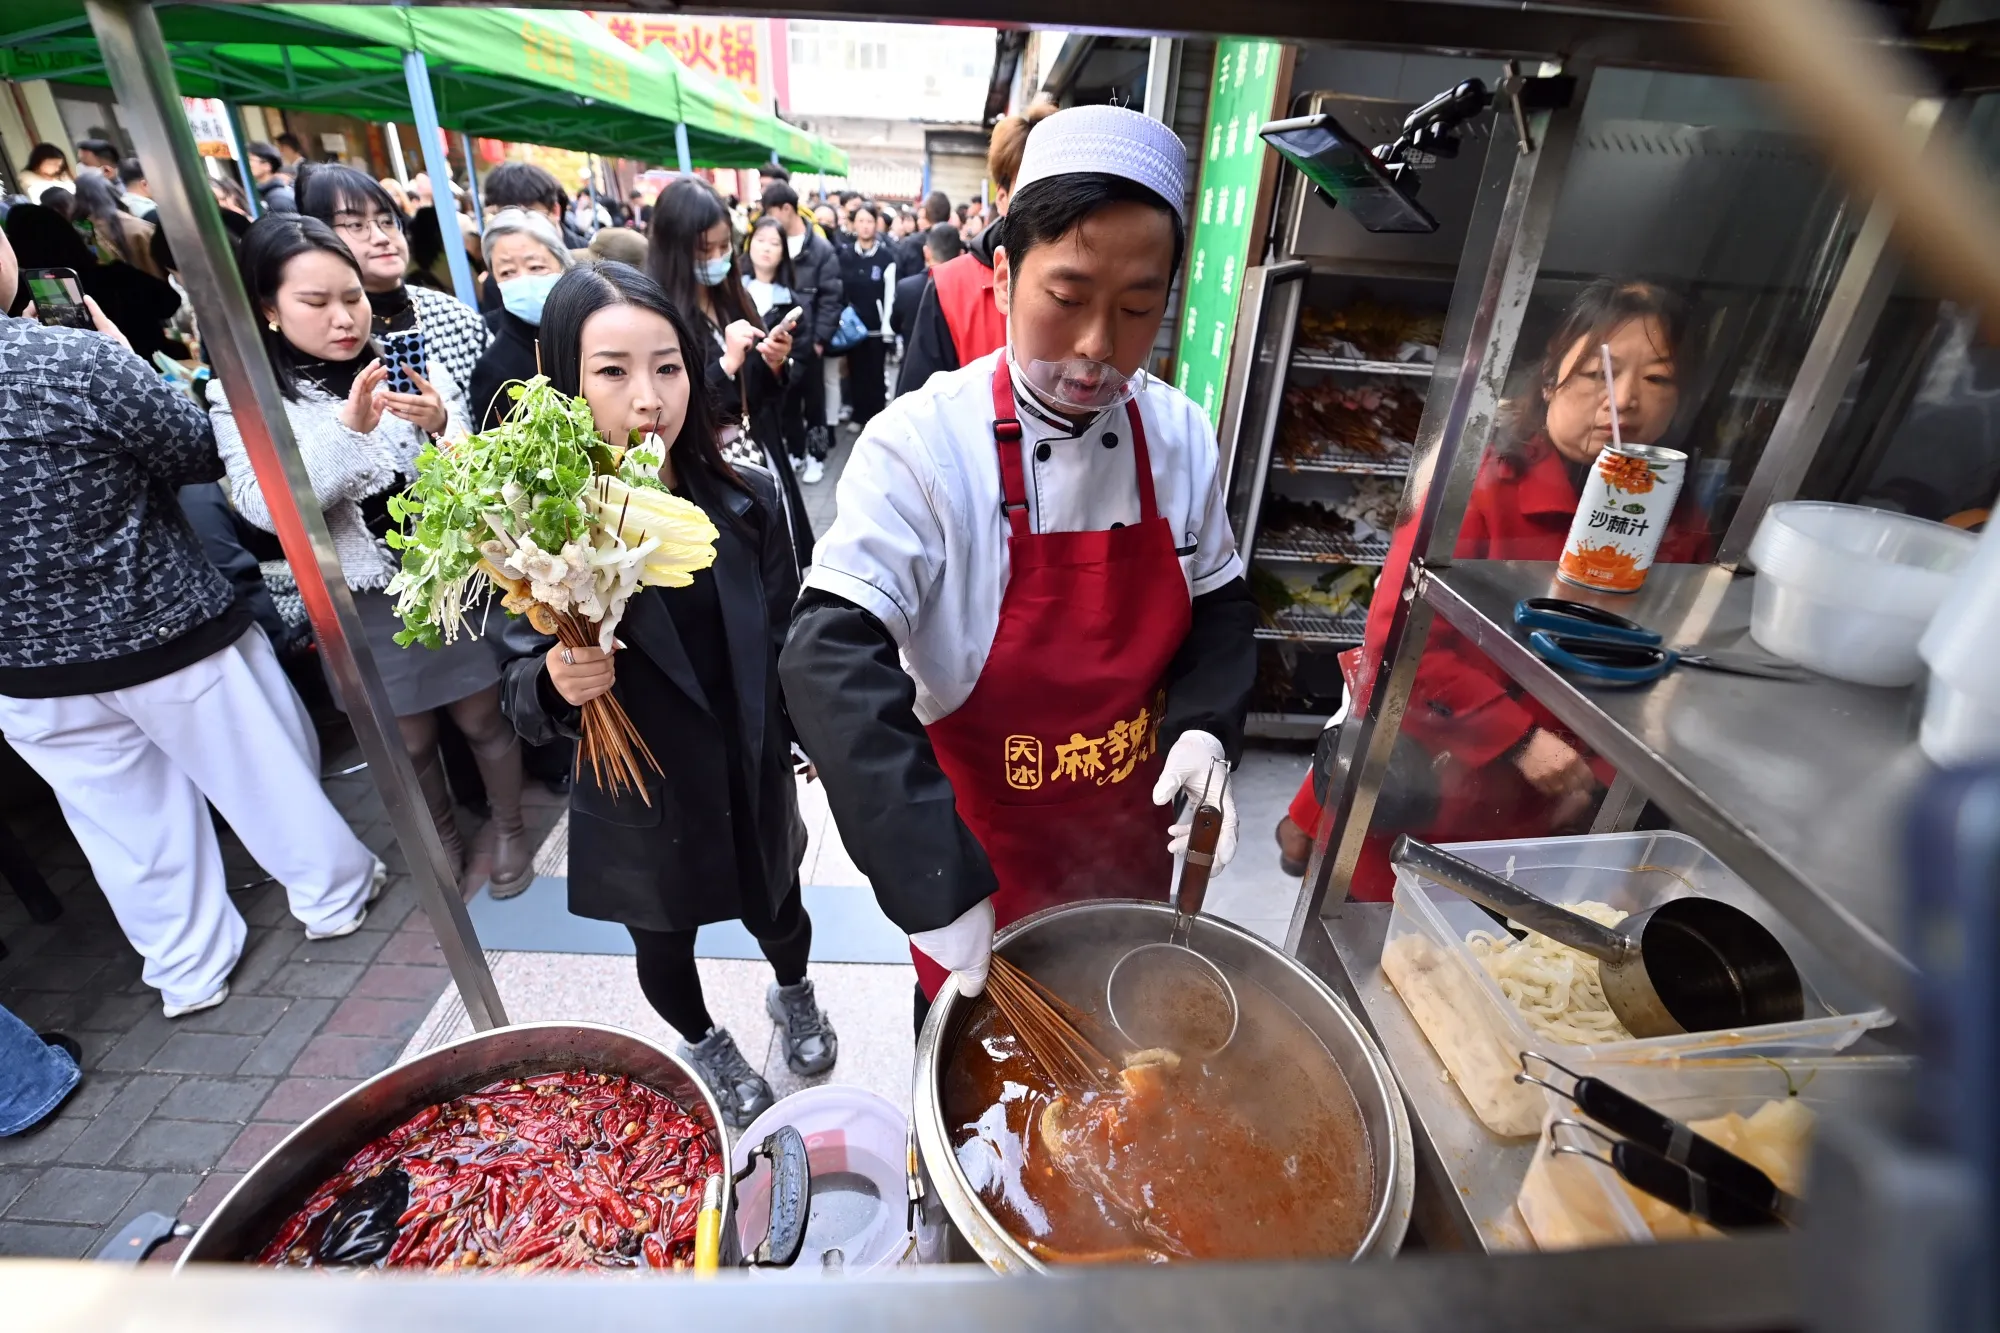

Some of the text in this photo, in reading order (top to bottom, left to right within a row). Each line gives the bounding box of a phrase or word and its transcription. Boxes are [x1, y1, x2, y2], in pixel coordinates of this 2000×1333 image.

[1588, 510, 1649, 536] 沙棘汁
[1051, 689, 1166, 784] 麻辣
[1010, 740, 1037, 784] 天水
